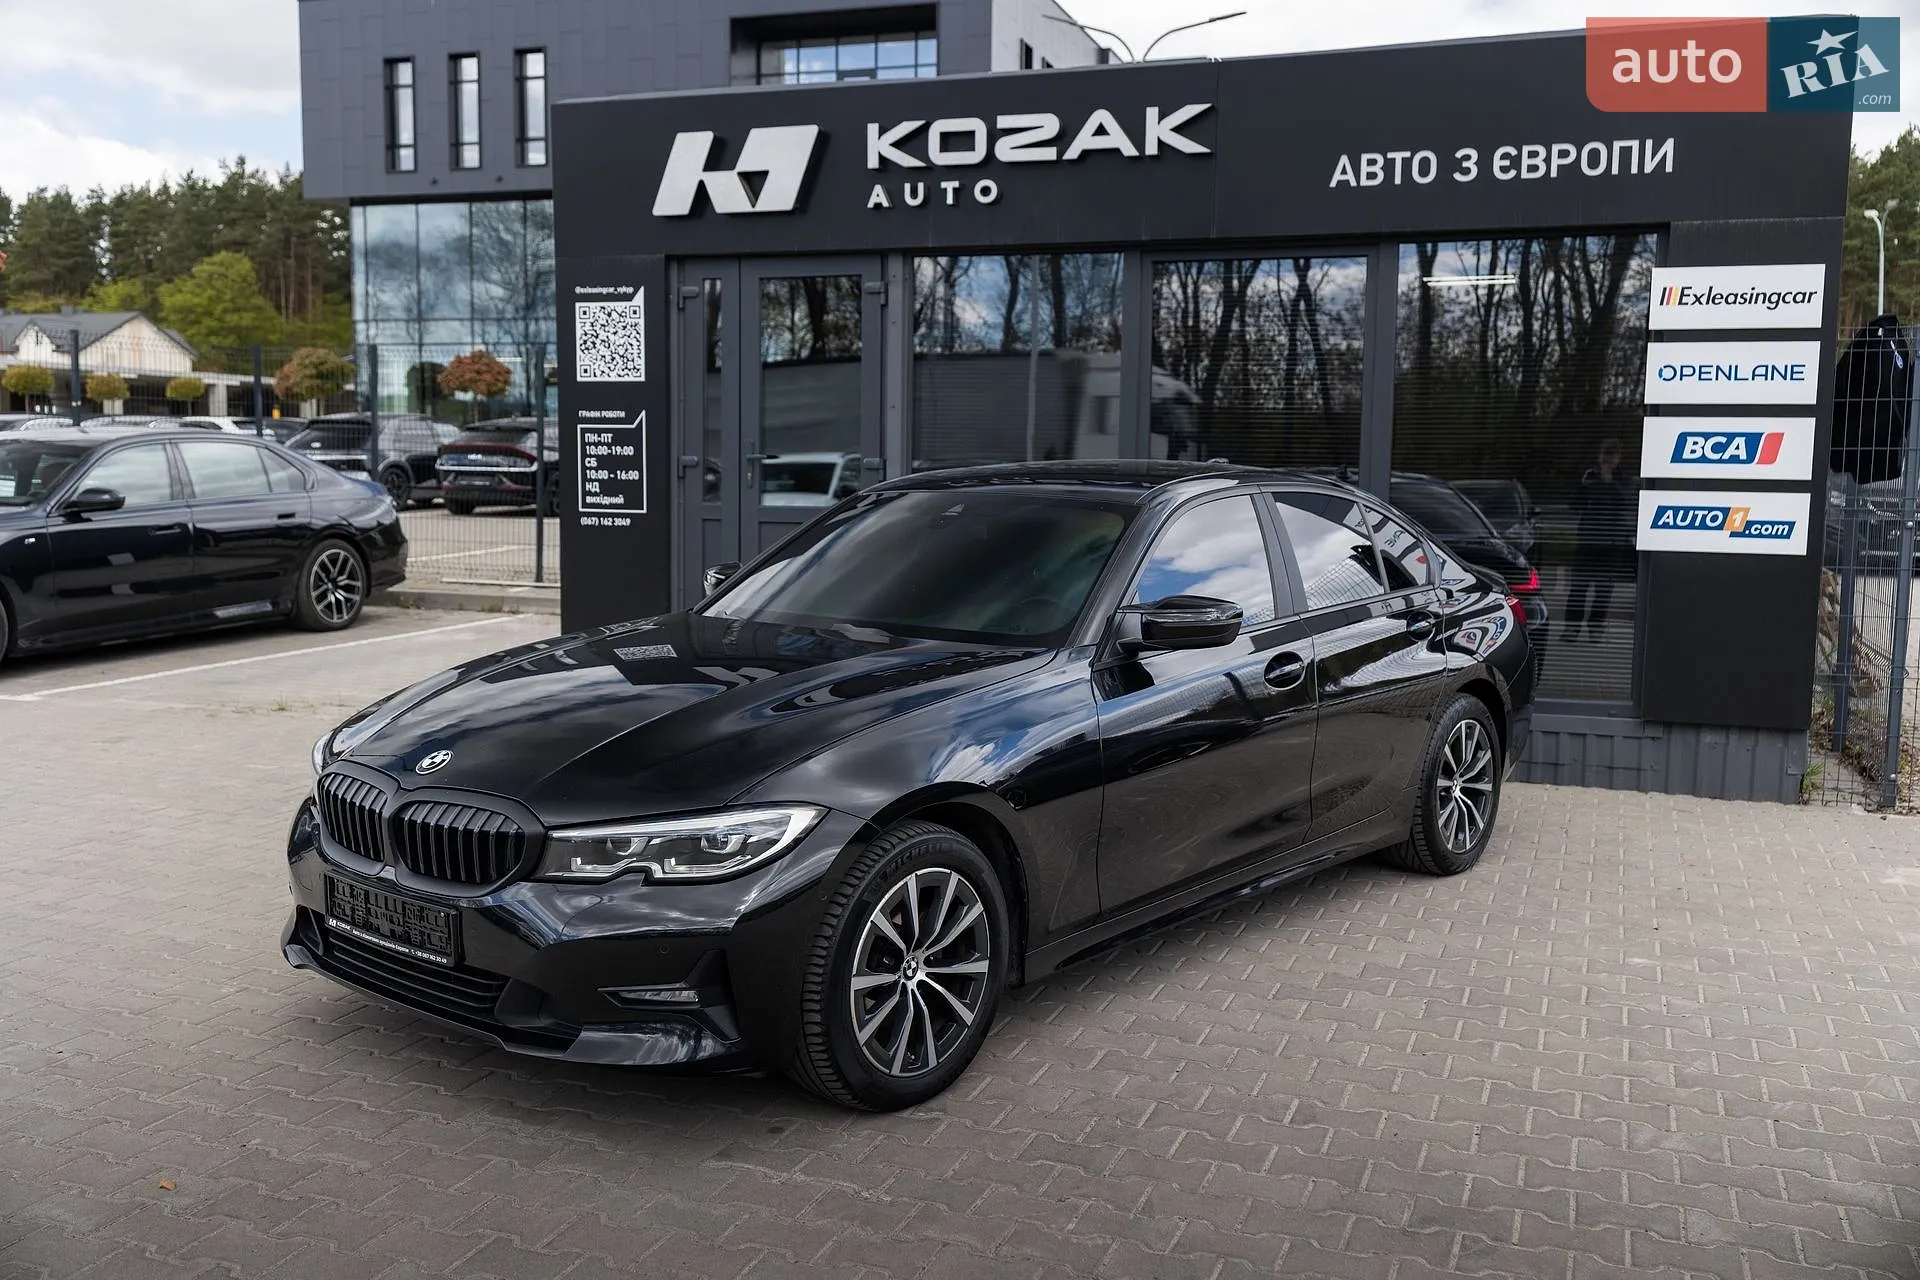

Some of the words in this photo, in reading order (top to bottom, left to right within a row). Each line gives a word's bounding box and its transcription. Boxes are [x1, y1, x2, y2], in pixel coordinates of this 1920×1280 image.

[867, 104, 1212, 169] KOZAK
[1329, 150, 1438, 188] АВТО
[1492, 137, 1675, 180] ЄВРОПИ
[867, 179, 998, 208] AUTO
[1678, 286, 1818, 311] Exleasingcar
[1657, 364, 1806, 382] OPENLANE
[585, 432, 613, 443] ПН-ПТ
[585, 445, 634, 456] 10:00-19:00
[1683, 437, 1748, 461] BCA
[585, 457, 598, 468] СБ
[586, 469, 609, 480] 10:00
[616, 470, 640, 481] 16:00
[585, 481, 600, 493] НД
[580, 516, 599, 527] (067)
[601, 517, 613, 526] 162
